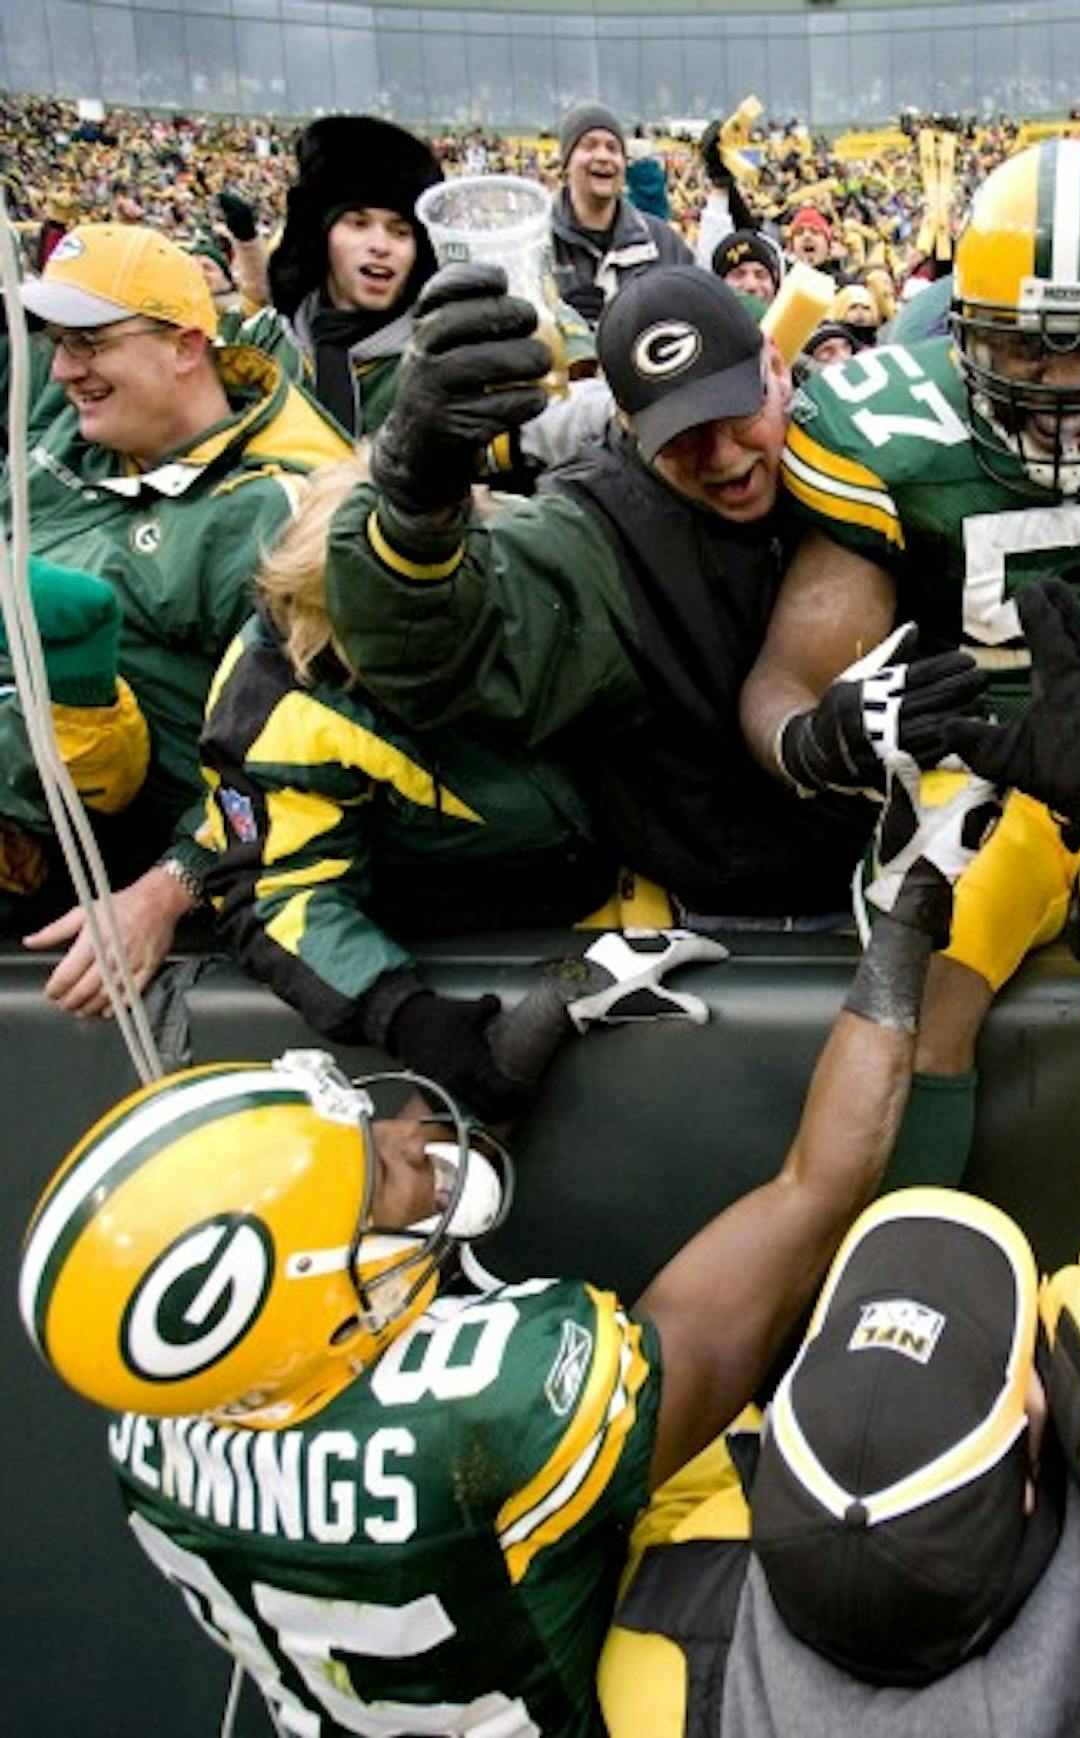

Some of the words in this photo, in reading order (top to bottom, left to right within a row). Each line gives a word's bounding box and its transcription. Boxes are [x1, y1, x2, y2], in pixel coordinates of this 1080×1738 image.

[632, 319, 702, 380] G
[821, 344, 971, 448] 57
[122, 1215, 273, 1383] G
[371, 1280, 540, 1407] 8
[862, 1325, 929, 1355] NFL
[108, 1411, 417, 1544] JENNINGS
